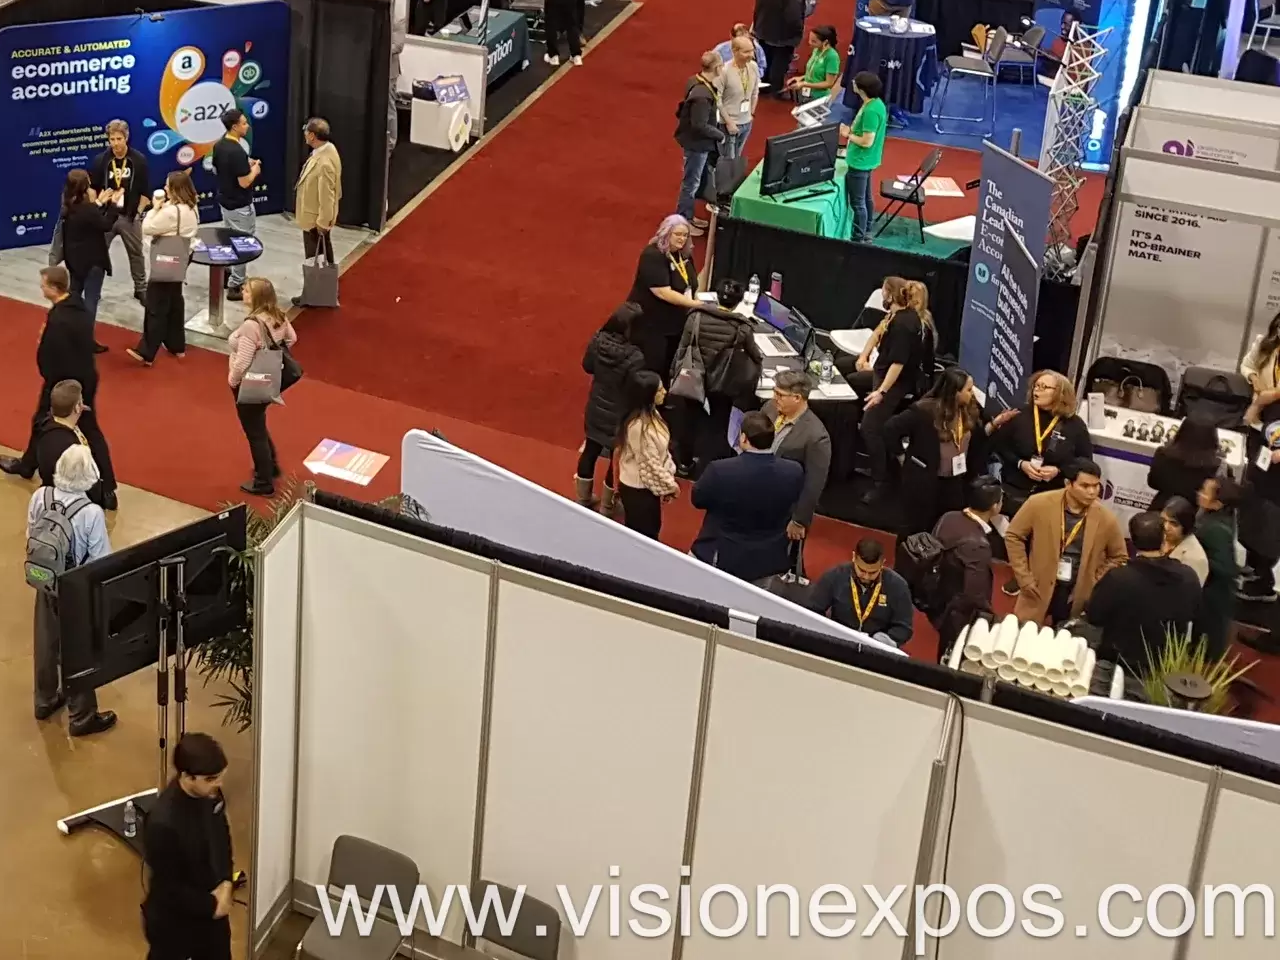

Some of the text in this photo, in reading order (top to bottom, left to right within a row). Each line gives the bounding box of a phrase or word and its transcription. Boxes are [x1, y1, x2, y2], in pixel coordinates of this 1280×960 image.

[11, 39, 131, 59] ACCURATE & AUTOMATED
[487, 39, 513, 75] gnition
[11, 54, 136, 79] ecommerce
[181, 55, 193, 69] a
[11, 74, 131, 100] accounting
[52, 126, 91, 136] understands
[22, 139, 58, 148] ecommerce
[59, 135, 93, 144] accounting
[987, 179, 1003, 200] The
[982, 209, 1006, 233] Lead
[985, 195, 1024, 229] Canadian
[1134, 209, 1169, 223] SINCE
[1171, 216, 1201, 229] 2016.
[1131, 230, 1163, 242] IT'S A
[1128, 249, 1163, 263] MATE.
[1129, 239, 1202, 260] NO-BRAINER
